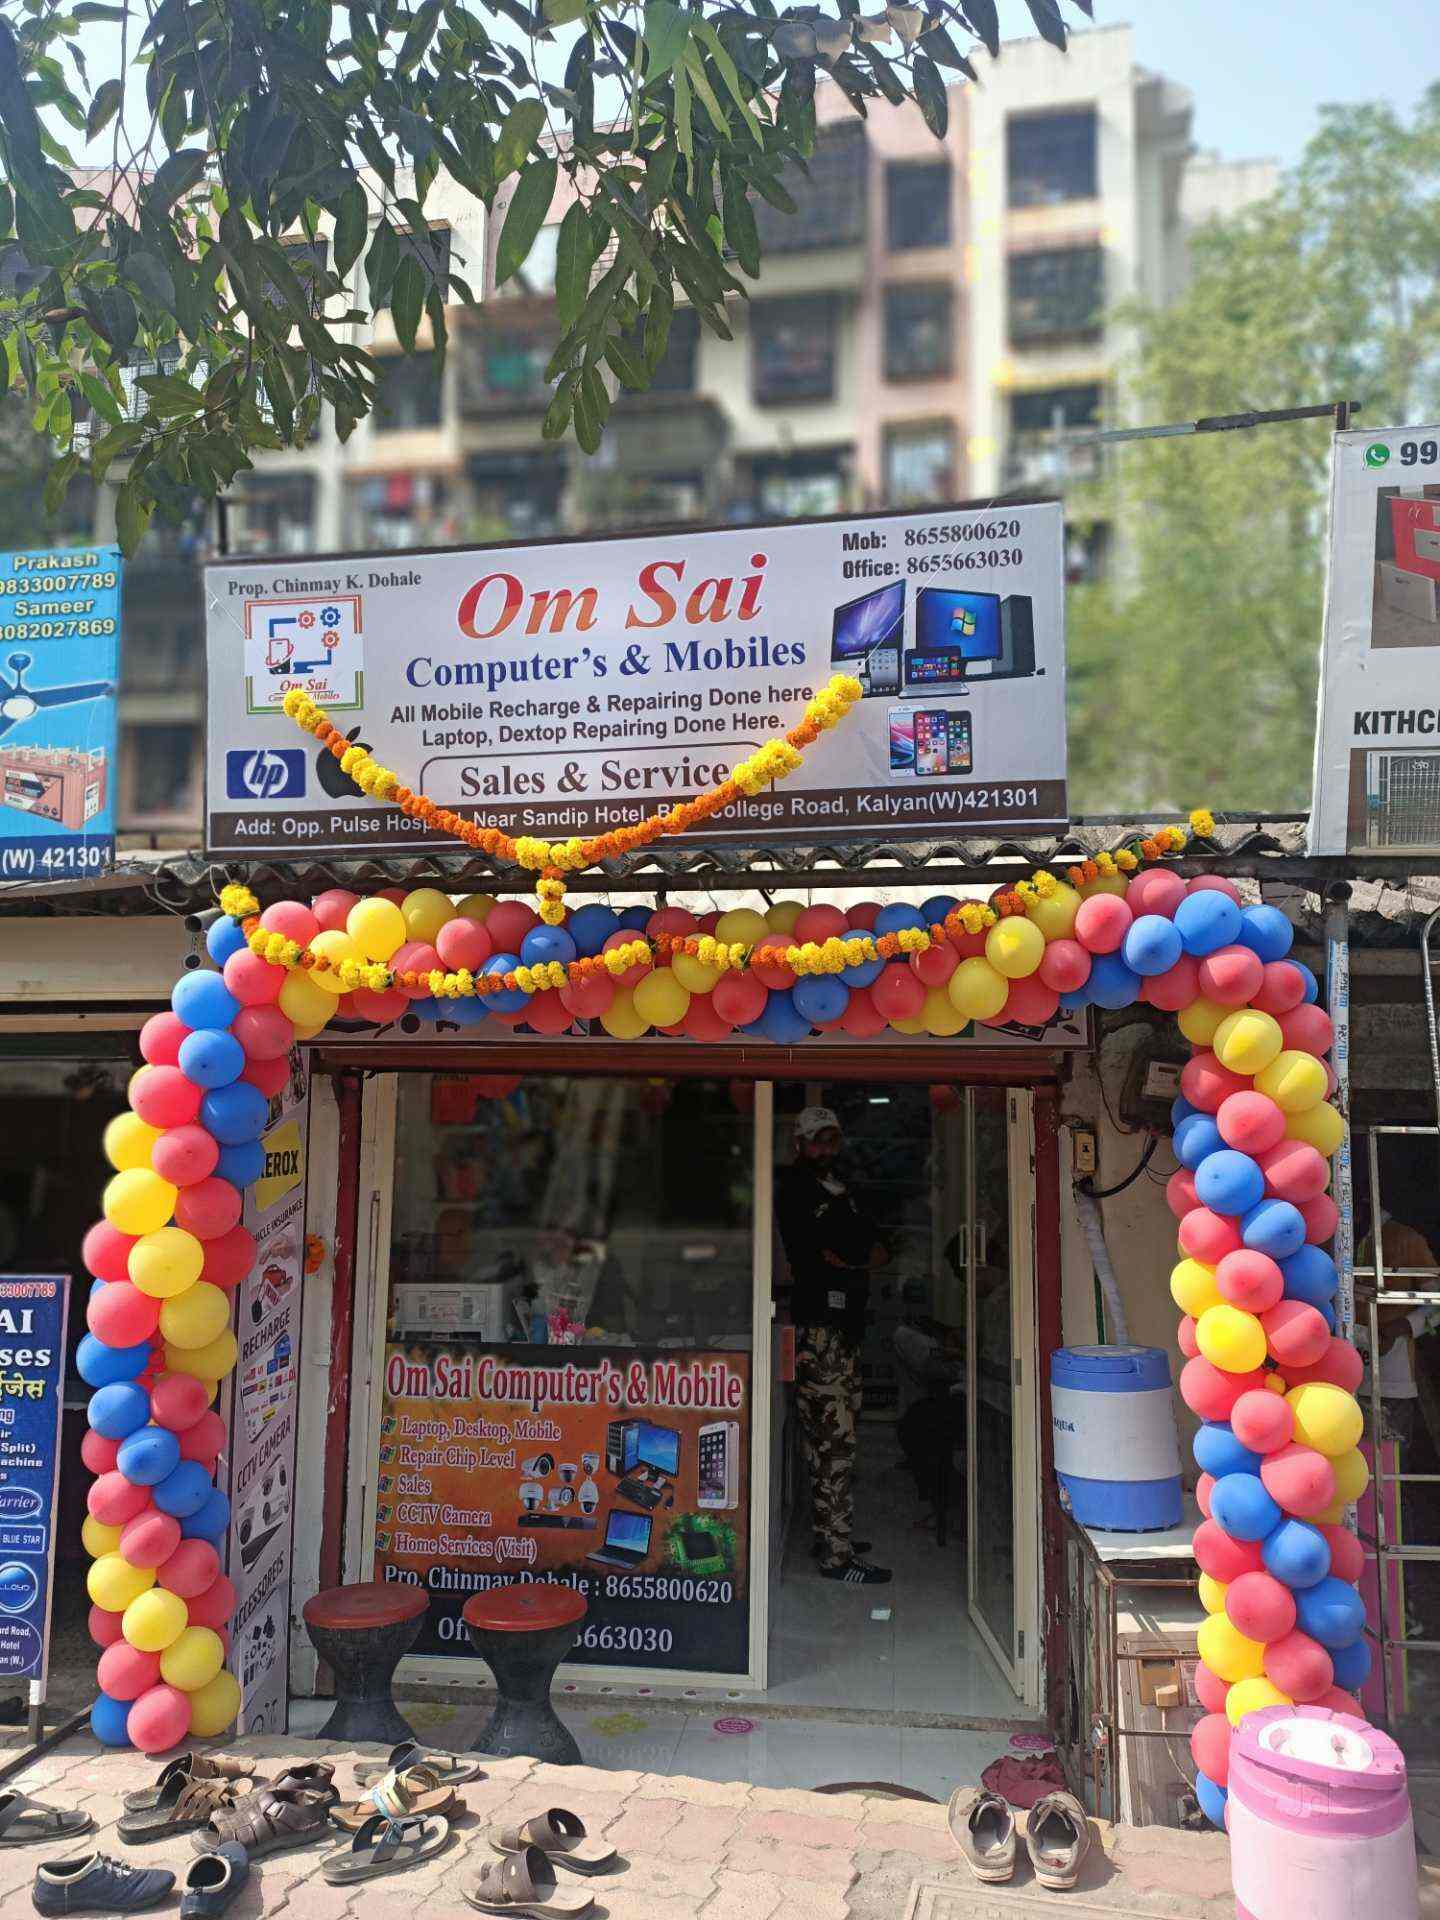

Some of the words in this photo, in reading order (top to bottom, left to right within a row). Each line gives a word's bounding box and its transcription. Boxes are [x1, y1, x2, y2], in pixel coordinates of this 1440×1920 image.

[1401, 440, 1438, 466] 99
[842, 530, 887, 551] Mob:
[904, 519, 1021, 547] 8655800620
[13, 553, 98, 572] Prakash
[842, 558, 900, 579] Office:
[906, 547, 1023, 575] 8655663030
[228, 580, 268, 598] Prop.
[272, 577, 341, 594] Chinmay
[346, 574, 363, 589] K.
[368, 570, 421, 588] Dohale
[457, 572, 600, 639] Om
[624, 552, 769, 631] Sai
[15, 599, 94, 616] Sameer
[0, 619, 115, 641] 082027869
[406, 647, 608, 692] Computer's
[619, 643, 652, 676] &
[664, 637, 807, 674] Mobiles
[306, 678, 328, 690] Sai
[390, 703, 415, 723] All
[421, 702, 484, 721] Mobile
[489, 699, 580, 719] Recharge
[586, 695, 601, 713] &
[607, 691, 703, 714] Repairing
[709, 687, 762, 706] Done
[422, 729, 493, 749] Laptop,
[499, 723, 567, 743] Dextop
[573, 719, 667, 742] Repairing
[674, 715, 726, 734] Done
[733, 712, 785, 731] Here.
[1353, 708, 1440, 736] KITHC
[248, 751, 285, 797] hp
[460, 765, 545, 797] Sales
[556, 761, 588, 793] &
[601, 755, 730, 791] Service
[235, 818, 276, 835] Add:
[282, 819, 324, 838] Opp.
[330, 814, 381, 833] Pulse
[473, 808, 516, 828] Near
[522, 804, 588, 829] Sandip
[791, 796, 850, 817] Road,
[2, 848, 35, 874] (W)
[262, 1149, 298, 1178] EROX
[242, 1306, 290, 1362] RECHARGE
[387, 1354, 429, 1397] Om
[434, 1355, 472, 1399] Sai
[477, 1357, 621, 1413] Computer's
[626, 1362, 648, 1405] &
[653, 1362, 742, 1409] Mobile
[402, 1417, 450, 1441] Laptop,
[453, 1417, 512, 1444] Desktop,
[515, 1419, 561, 1440] Mobile
[400, 1446, 444, 1470] Repair
[446, 1447, 478, 1472] Chip
[480, 1449, 516, 1469] Level
[399, 1475, 432, 1495] Sales
[0, 1495, 37, 1508] arrier
[398, 1503, 440, 1524] CCTV
[442, 1503, 492, 1526] Camera
[3, 1534, 20, 1544] BLUE
[22, 1535, 40, 1544] STAR
[394, 1532, 438, 1555] Home
[439, 1535, 493, 1557] Services
[494, 1536, 538, 1564] (Visit)
[605, 1574, 733, 1604] 8655800620
[572, 1623, 673, 1652] 663030
